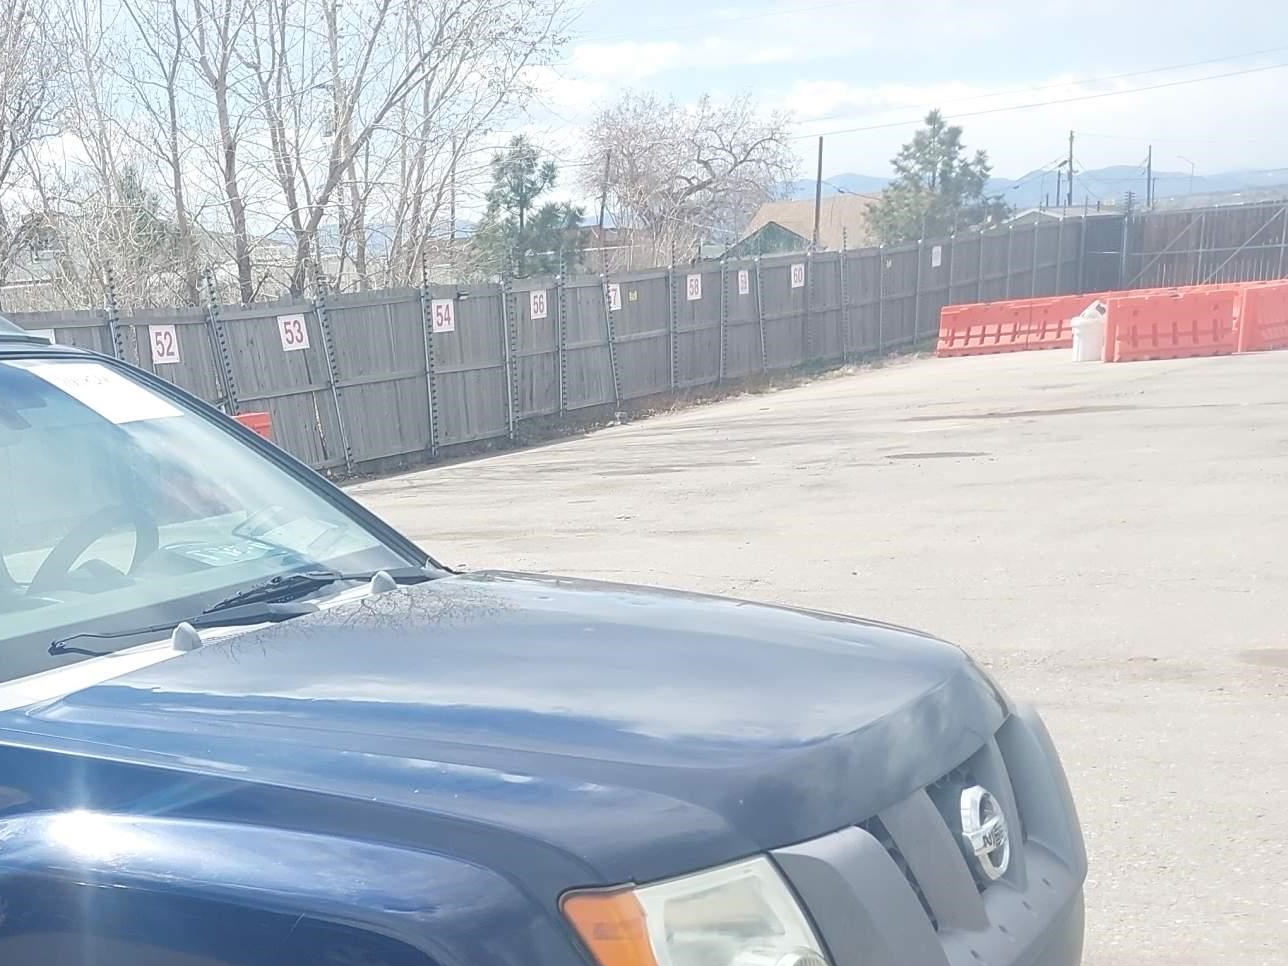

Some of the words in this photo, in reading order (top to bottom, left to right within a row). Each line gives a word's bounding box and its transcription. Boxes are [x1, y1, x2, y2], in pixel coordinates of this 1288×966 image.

[436, 304, 451, 327] 54
[533, 294, 544, 314] 56
[284, 320, 304, 344] 53
[155, 331, 175, 357] 52
